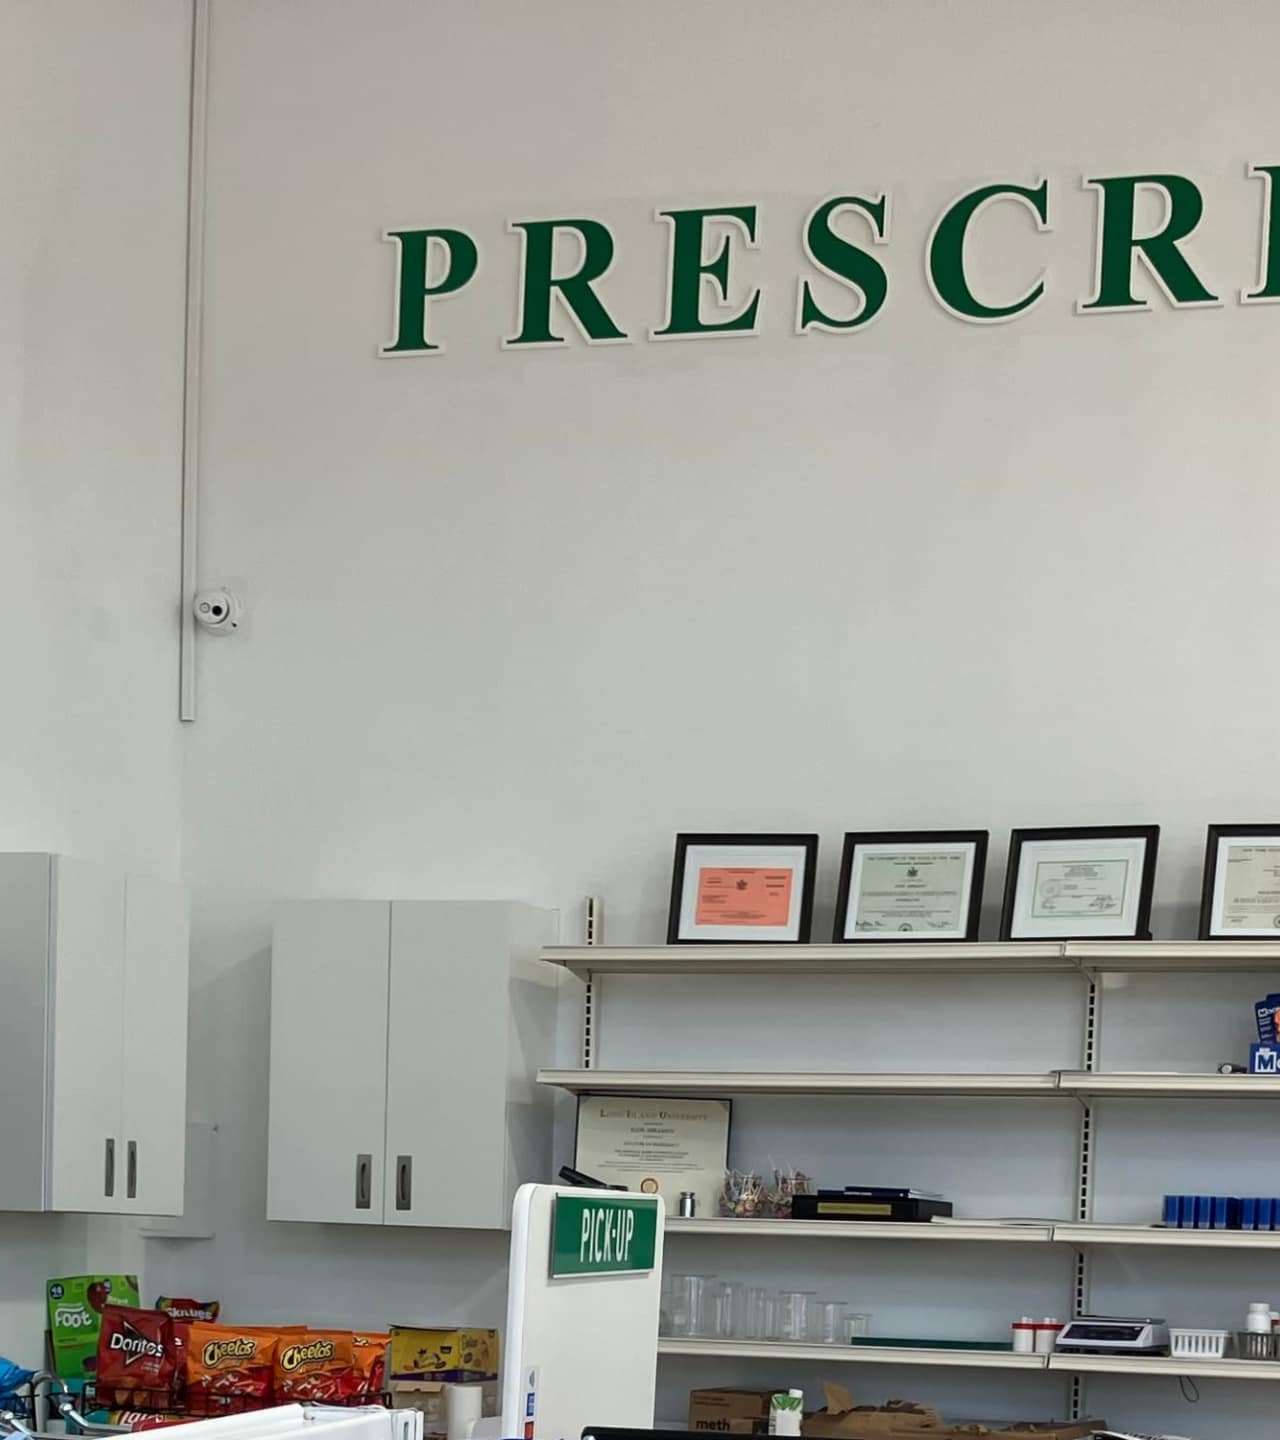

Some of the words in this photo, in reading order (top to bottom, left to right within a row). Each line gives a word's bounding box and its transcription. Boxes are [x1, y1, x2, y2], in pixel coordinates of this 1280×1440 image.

[580, 1208, 634, 1263] PICK-UP
[110, 1333, 164, 1357] Doritos
[203, 1338, 256, 1365] Cheetos
[282, 1340, 335, 1371] Cheetos
